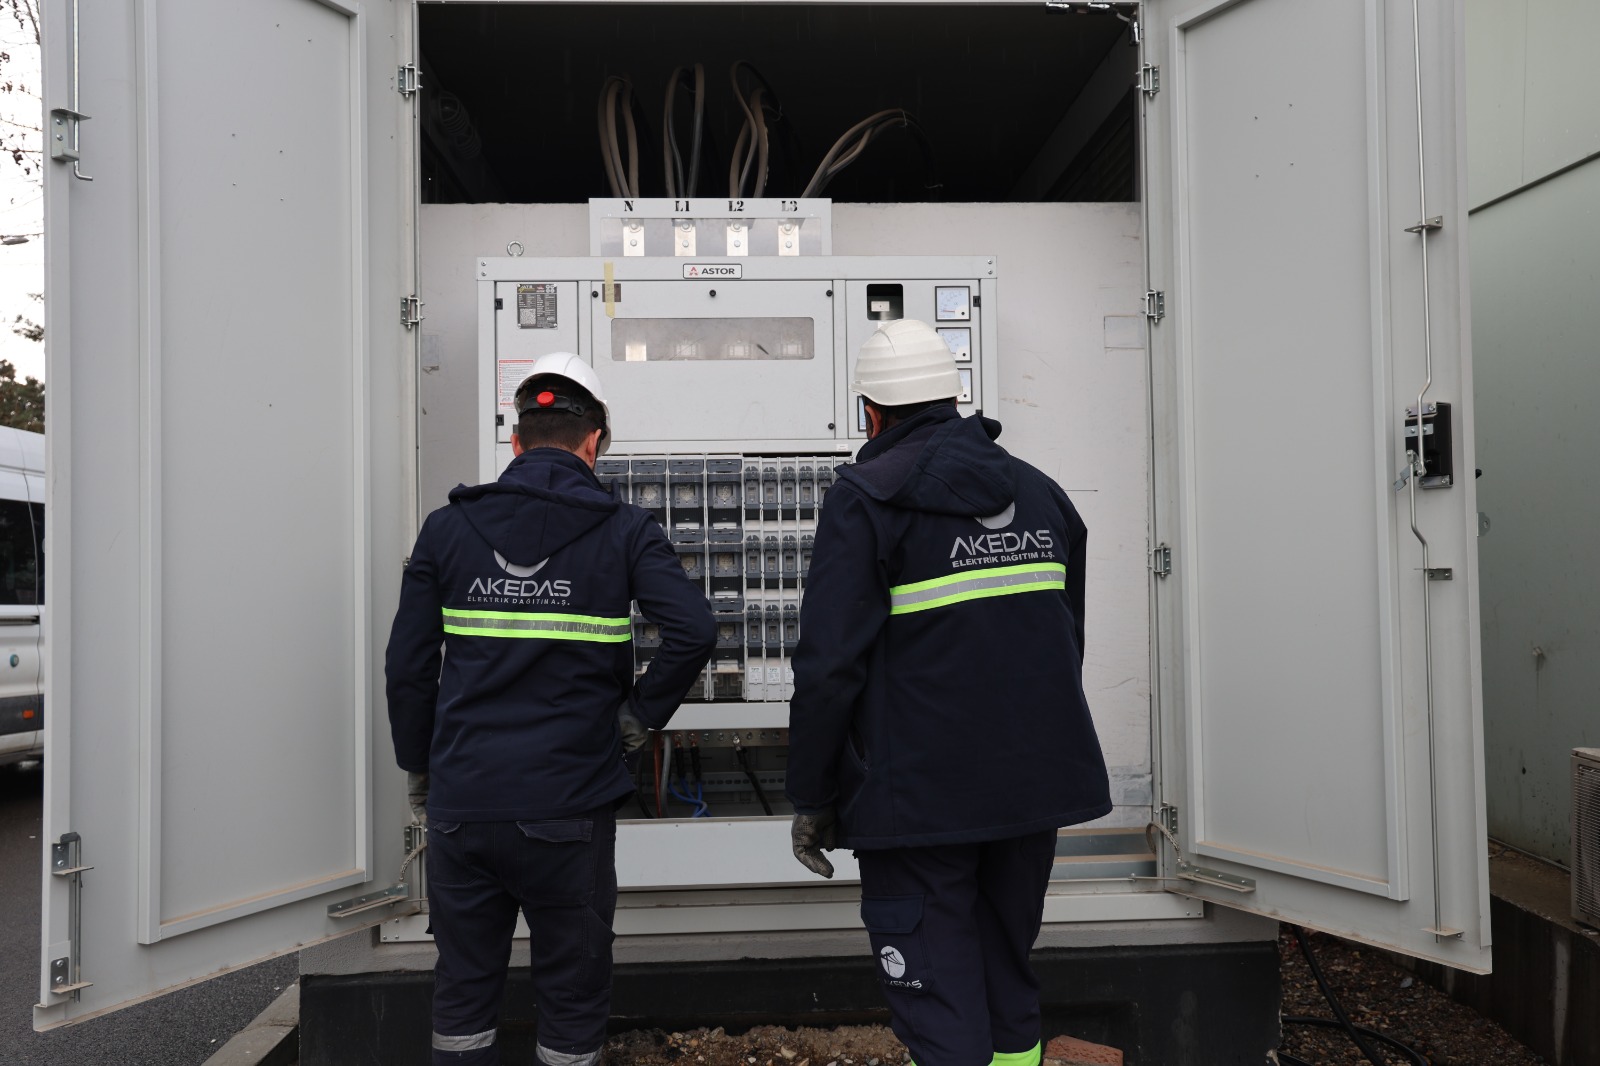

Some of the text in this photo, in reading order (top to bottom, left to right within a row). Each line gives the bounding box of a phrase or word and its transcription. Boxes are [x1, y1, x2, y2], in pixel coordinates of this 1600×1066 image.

[623, 201, 798, 212] N L1 L2 L3
[701, 267, 735, 275] ASTOR
